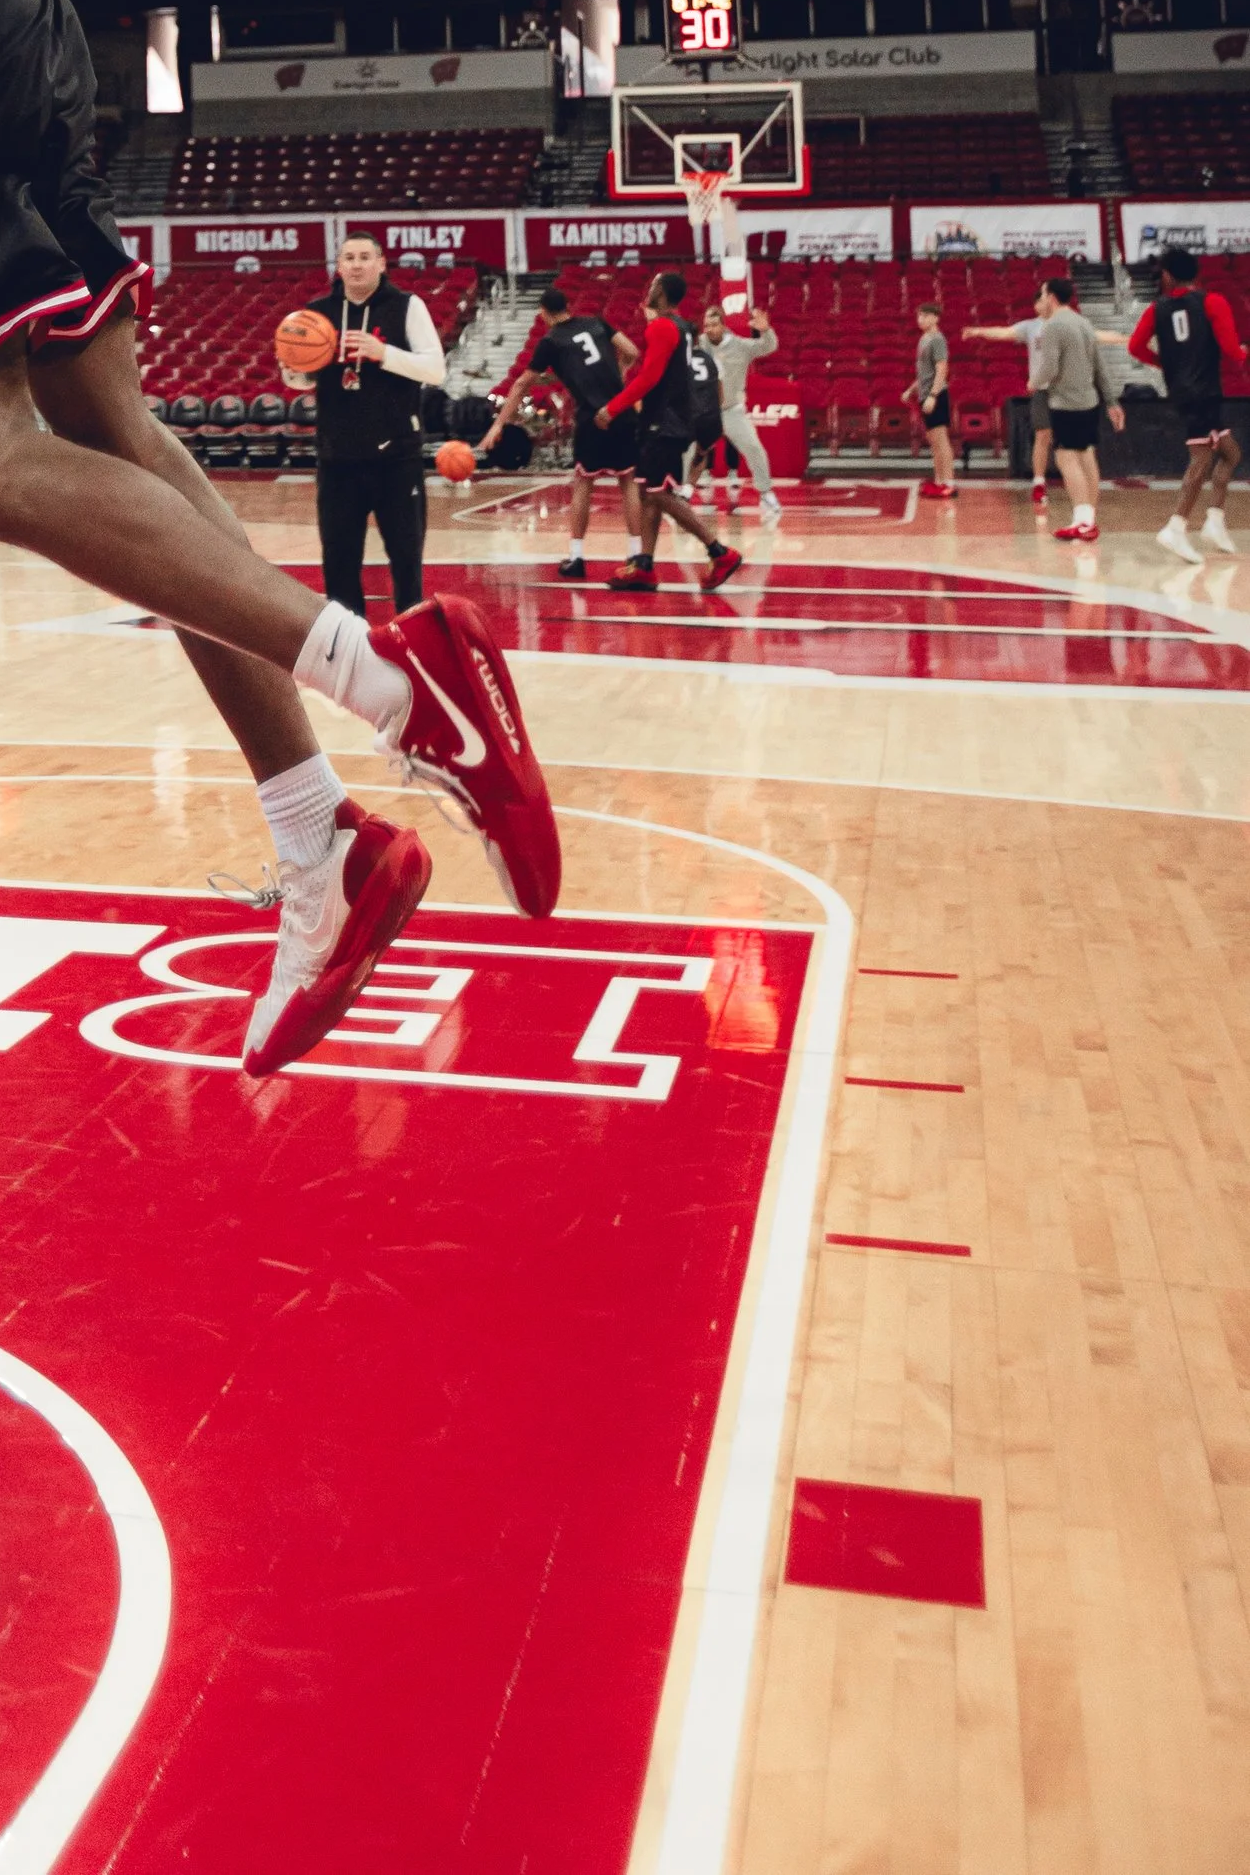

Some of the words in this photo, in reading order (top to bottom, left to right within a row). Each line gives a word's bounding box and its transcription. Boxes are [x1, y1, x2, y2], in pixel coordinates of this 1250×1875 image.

[680, 8, 731, 50] 30
[825, 46, 881, 68] Solar
[888, 44, 942, 66] Club
[195, 228, 299, 253] NICHOLAS
[386, 225, 466, 249] FINLEY
[549, 222, 668, 246] KAMINSKY
[572, 331, 601, 366] 3
[690, 357, 709, 381] 5
